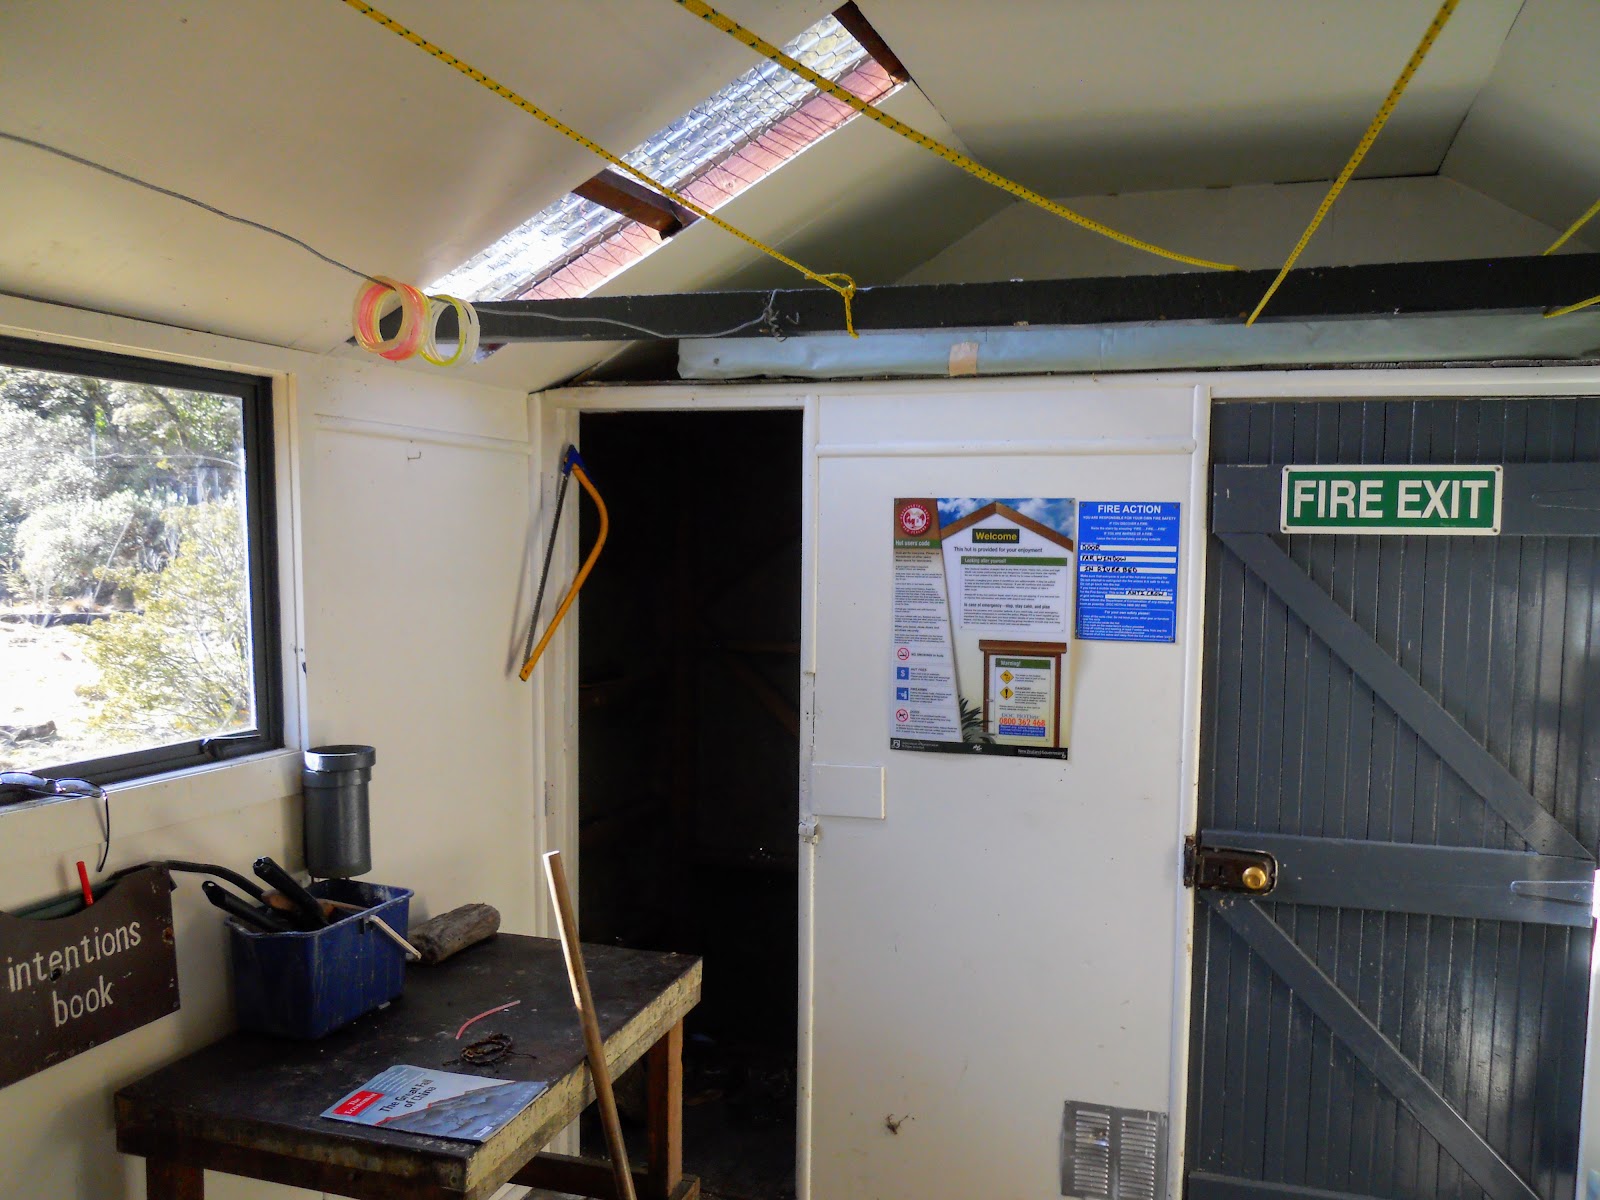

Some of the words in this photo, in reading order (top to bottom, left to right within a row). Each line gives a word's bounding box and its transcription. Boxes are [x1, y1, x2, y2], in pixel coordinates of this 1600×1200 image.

[1098, 504, 1120, 514] FIRE
[1122, 505, 1162, 514] ACTION
[1293, 480, 1384, 518] FIRE
[1397, 480, 1489, 519] EXIT
[976, 532, 1018, 541] Welcome
[7, 921, 142, 992] intentions
[52, 975, 114, 1028] book
[344, 1093, 378, 1114] Economist
[378, 1102, 400, 1112] The
[395, 1084, 421, 1102] Great
[404, 1099, 416, 1108] of
[411, 1086, 437, 1101] China
